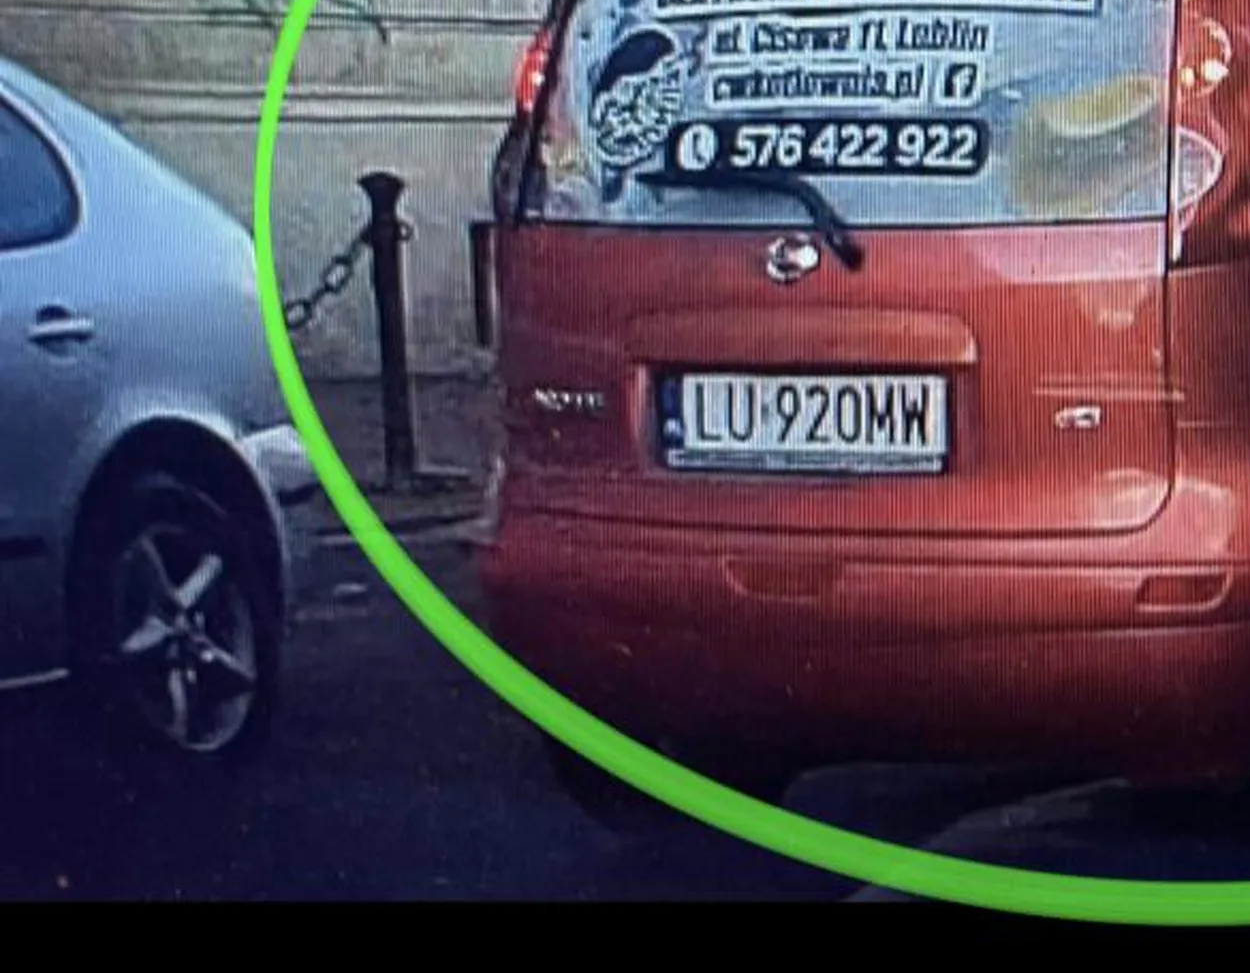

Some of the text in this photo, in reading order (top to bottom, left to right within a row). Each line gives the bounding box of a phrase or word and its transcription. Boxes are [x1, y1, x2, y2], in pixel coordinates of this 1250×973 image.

[730, 124, 979, 168] 576 422 922
[695, 382, 930, 445] LU 920MW
